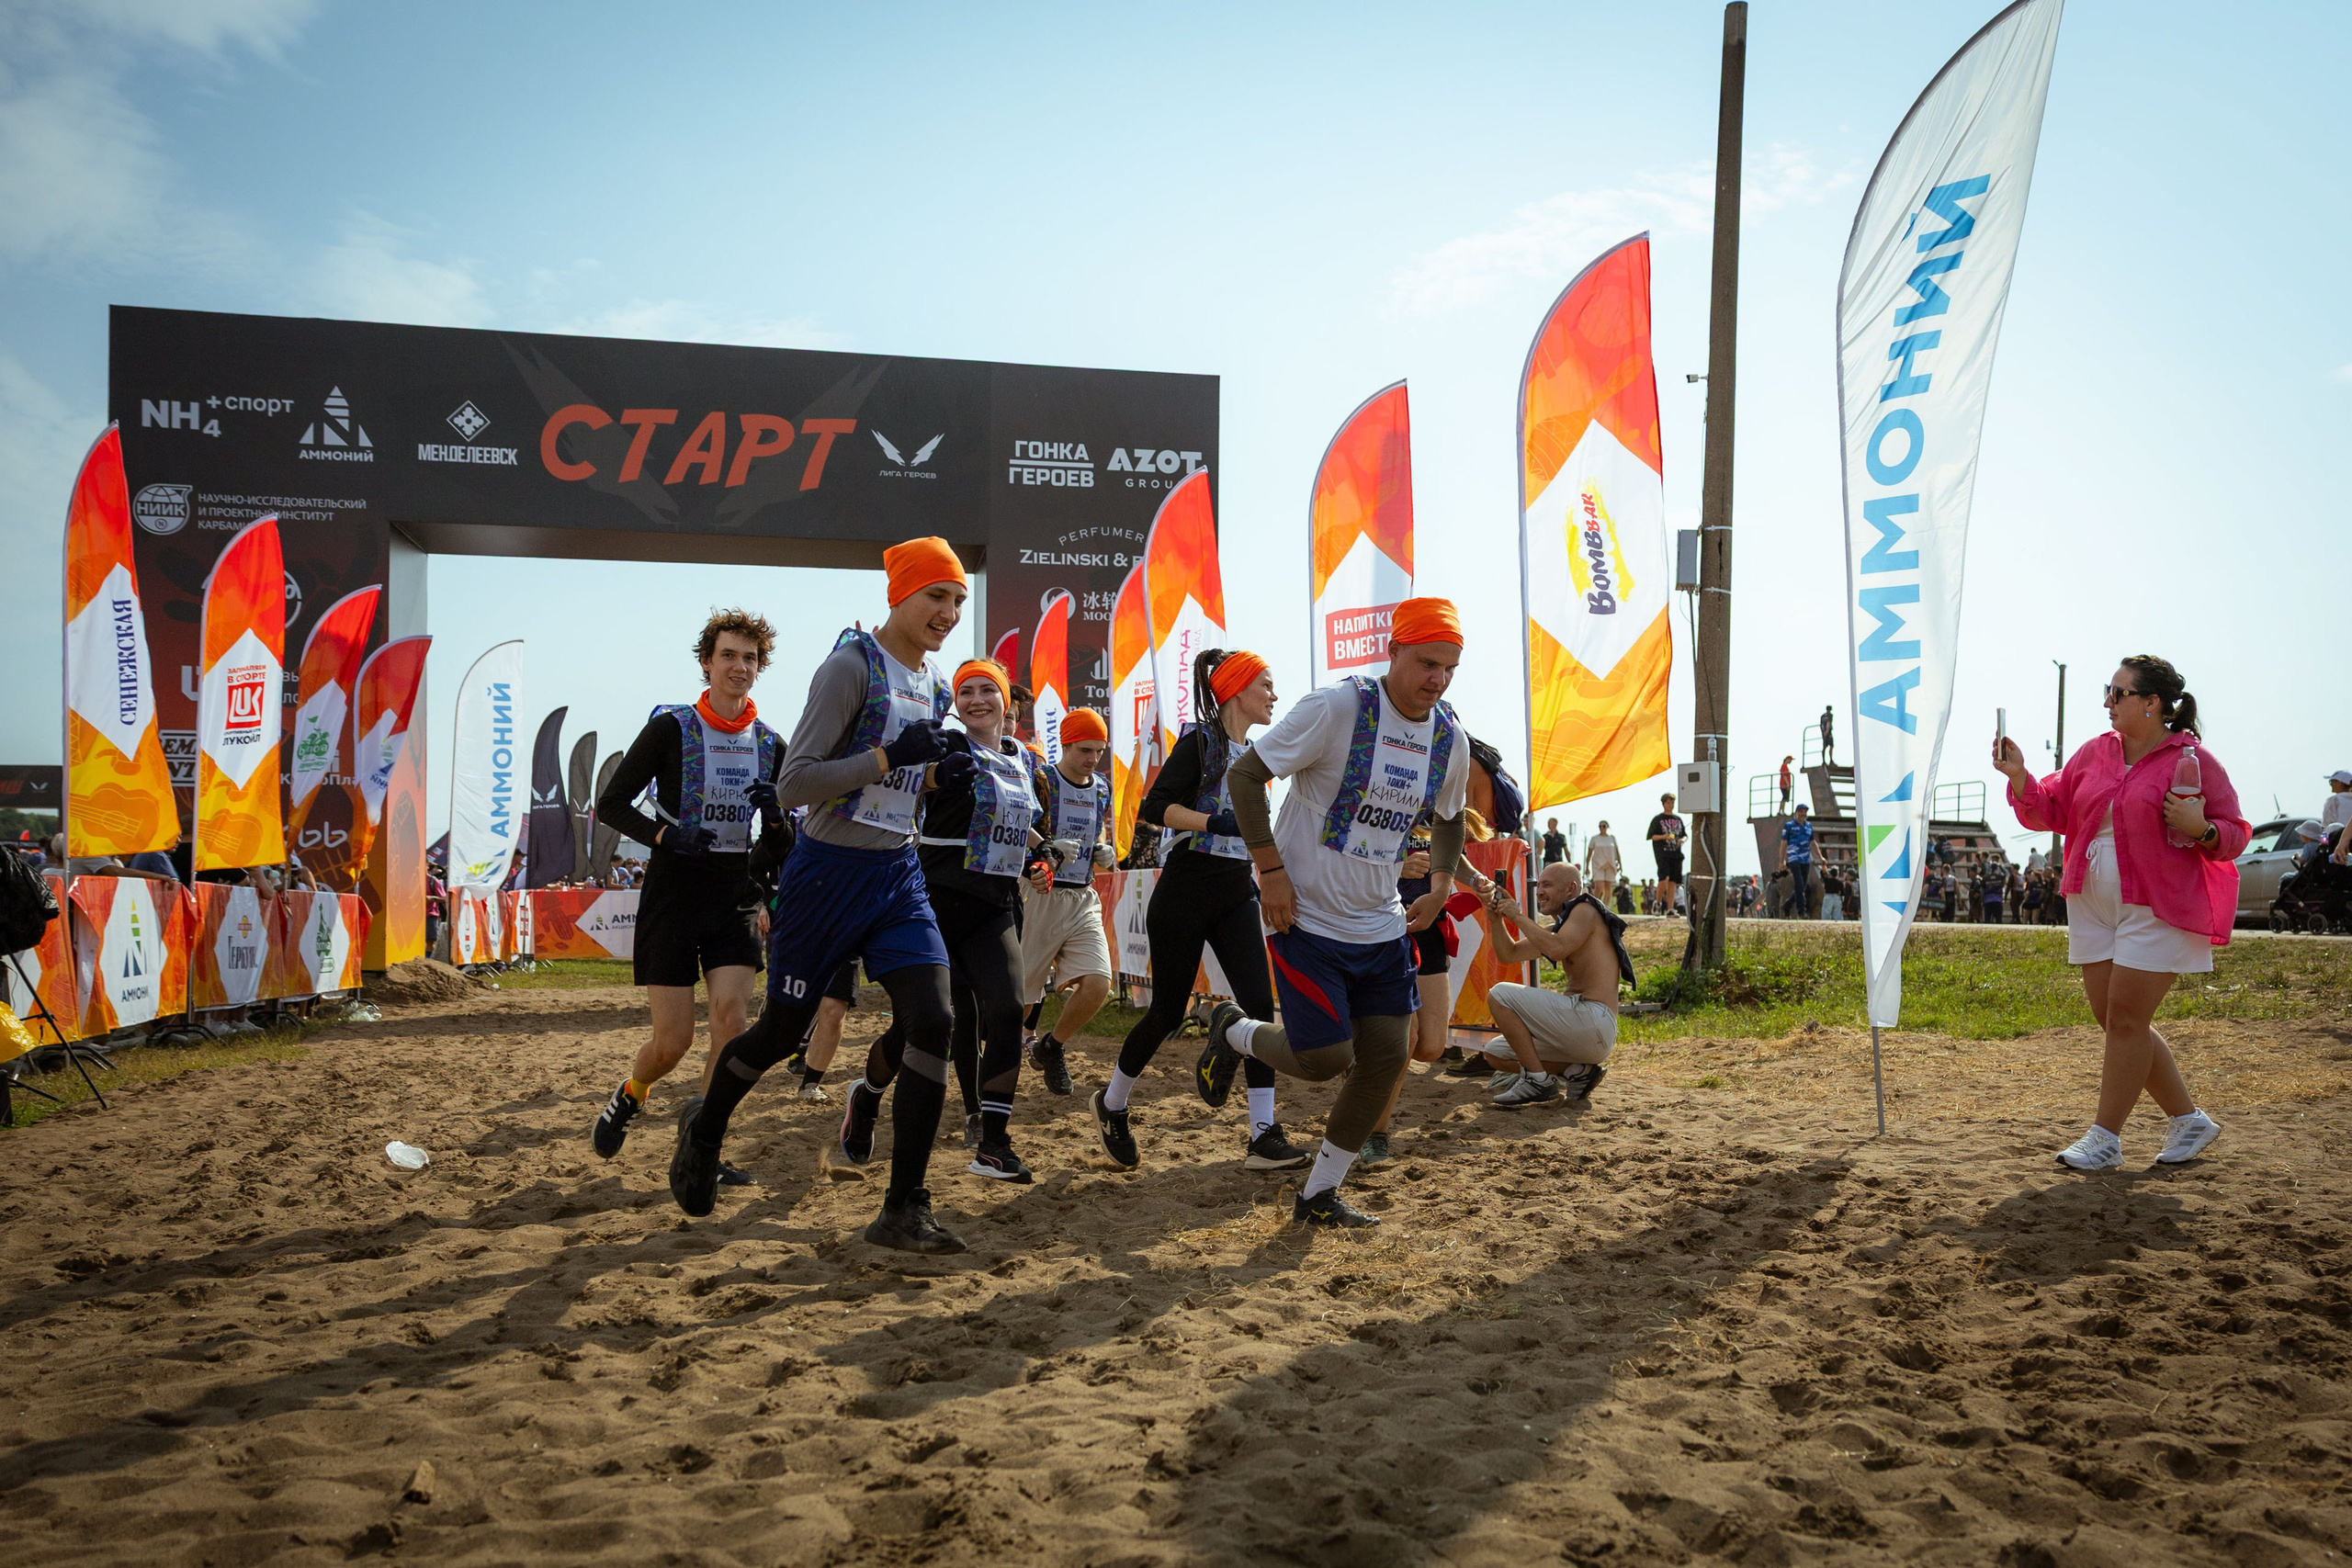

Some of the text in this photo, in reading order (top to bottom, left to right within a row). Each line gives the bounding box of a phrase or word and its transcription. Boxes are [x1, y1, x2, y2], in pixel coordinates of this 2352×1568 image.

[299, 449, 374, 462] АММОНИЙ
[418, 444, 518, 465] МЕНДЕЛЕЕВСК
[540, 403, 856, 491] СТАРТ
[1015, 440, 1089, 460] ГОНКА
[1859, 174, 1991, 736] АММОНИЙ
[1106, 447, 1202, 475] AZOT
[1009, 468, 1094, 488] ГЕРОЕВ
[1125, 479, 1173, 490] GROU
[137, 502, 186, 516] НИИК
[198, 493, 367, 510] НАУЧНО-ИССЛЕДОВАТЕЛЬСКИЙ
[198, 507, 206, 515] И
[277, 511, 334, 521] ИНСТИТУТ
[1058, 526, 1145, 546] PERFUMER
[1020, 549, 1108, 566] ZIELINSKI
[1113, 553, 1127, 567] &
[1082, 592, 1117, 610] 冰轮
[1082, 612, 1111, 620] MOO
[1335, 634, 1392, 660] ВМЕСТ
[112, 599, 137, 726] СЕНЕЖСКАЯ
[227, 675, 234, 683] В
[894, 687, 914, 698] ГОНКА
[1085, 684, 1110, 698] Tot
[1141, 686, 1155, 694] СПО
[222, 734, 260, 746] ЛУКОЙЛ
[1046, 708, 1057, 764] РКУЛЕС
[1383, 736, 1428, 752] ГОНКА ГЕРОЕВ
[487, 682, 513, 838] АММОНИЙ
[717, 767, 750, 776] КОМАНДА
[994, 768, 1011, 776] ГОНКА
[1385, 763, 1419, 781] КОМАНДА
[721, 777, 745, 786] 10КМ+
[874, 768, 922, 795] 3810
[1386, 776, 1411, 790] 10КМ+
[711, 786, 750, 801] КИРЮ
[1370, 782, 1419, 809] КИРИЛЛ
[1067, 816, 1090, 825] КОМАНДА
[1357, 804, 1413, 833] 03805
[992, 825, 1027, 847] 0380
[783, 975, 806, 998] 10
